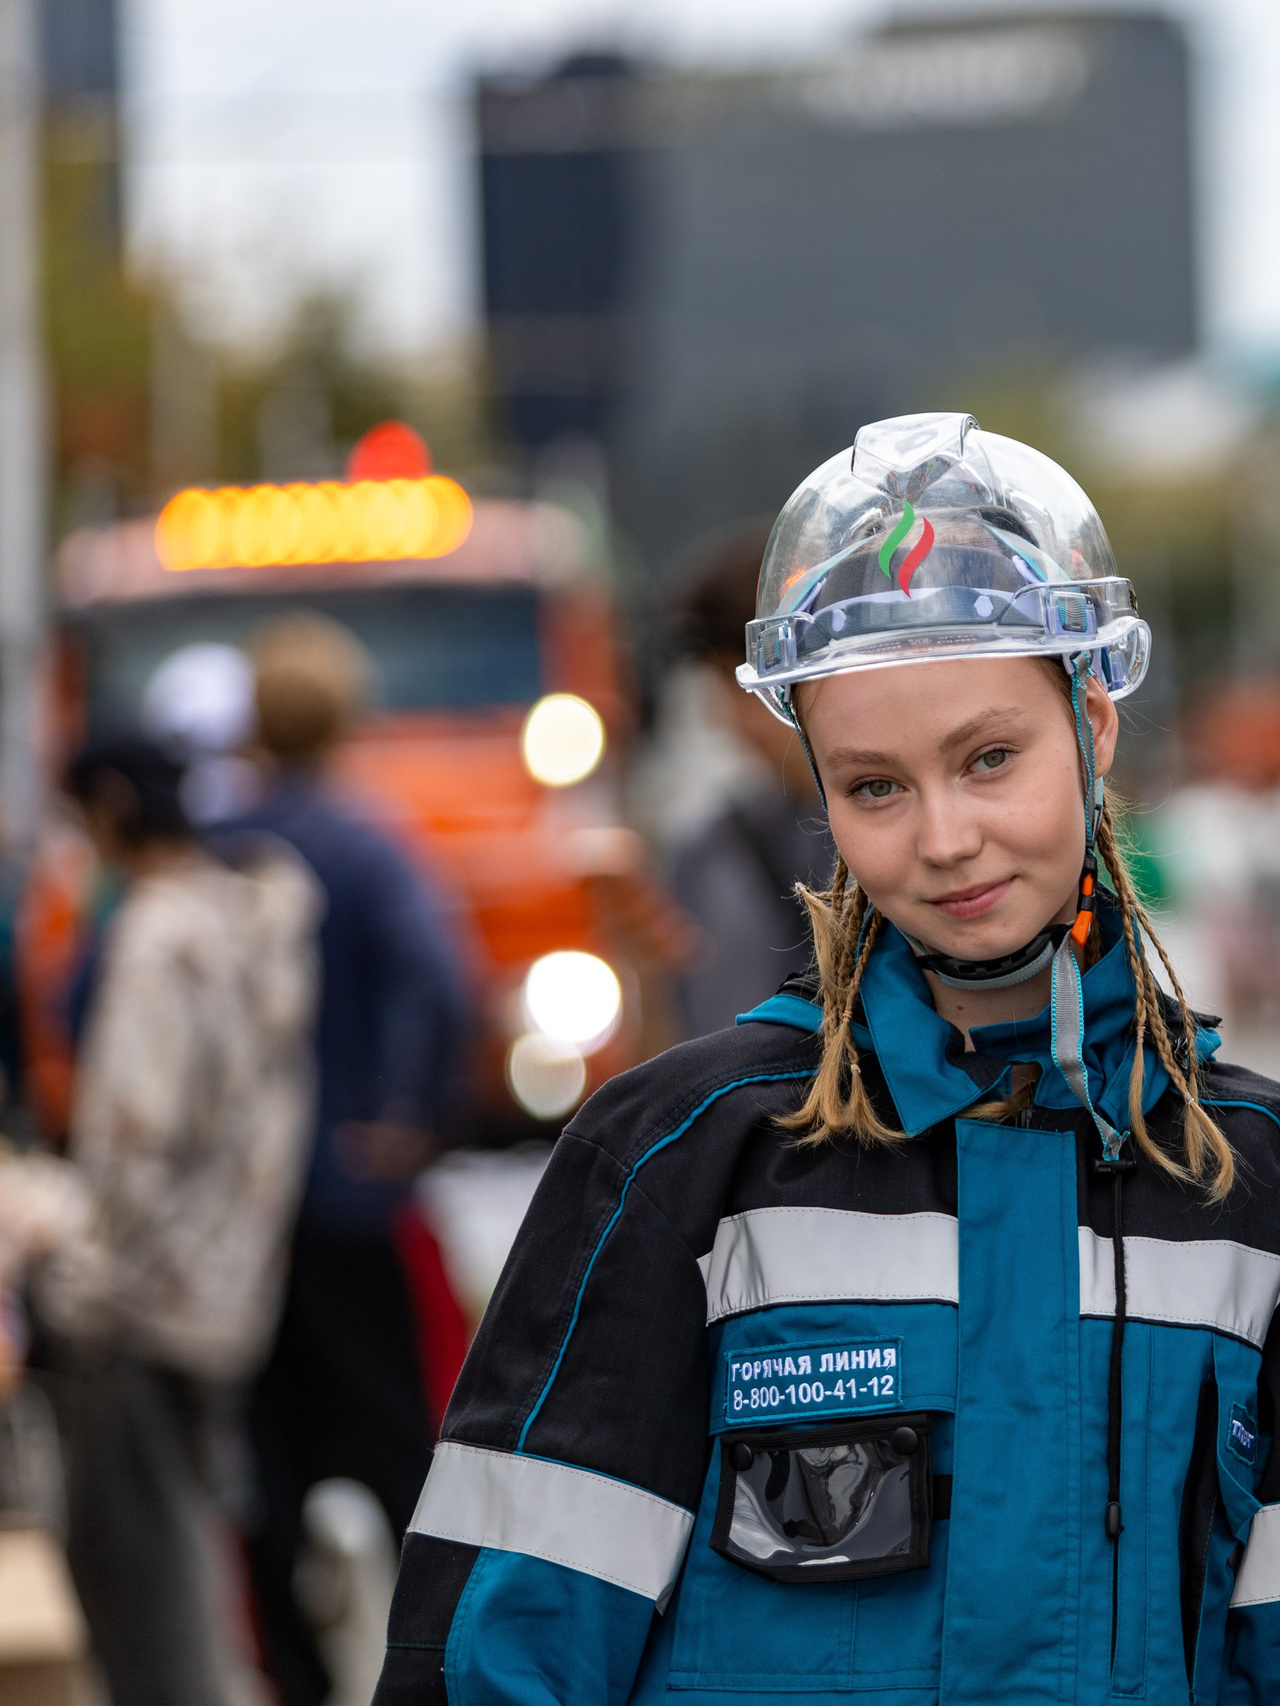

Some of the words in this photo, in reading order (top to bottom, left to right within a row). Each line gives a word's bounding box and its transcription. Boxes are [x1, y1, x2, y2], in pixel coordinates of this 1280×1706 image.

[731, 1355, 812, 1382] ГОРЯЧАЯ
[819, 1348, 897, 1373] ЛИНИЯ
[733, 1374, 895, 1410] 8-800-100-41-12
